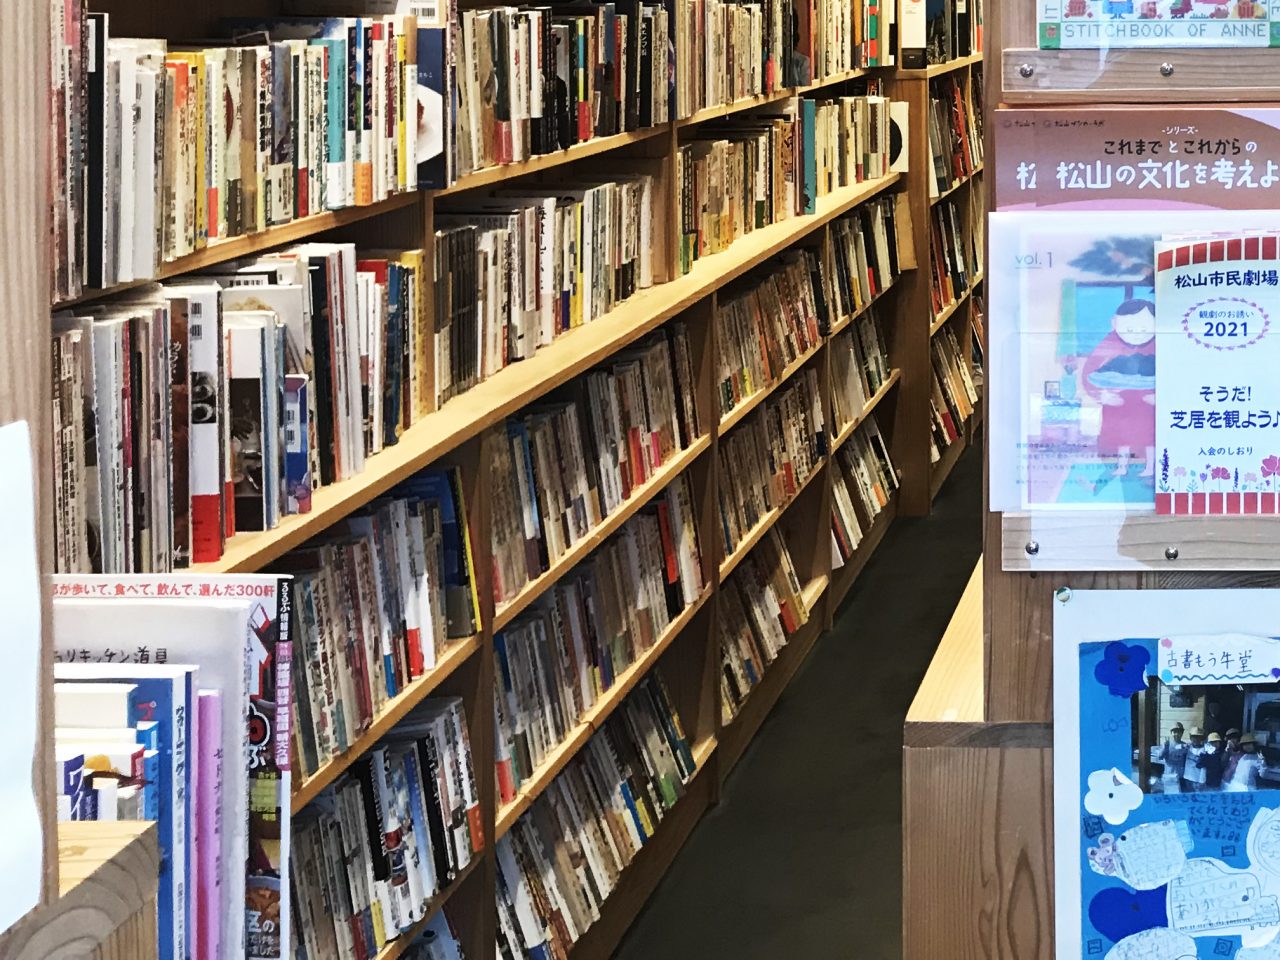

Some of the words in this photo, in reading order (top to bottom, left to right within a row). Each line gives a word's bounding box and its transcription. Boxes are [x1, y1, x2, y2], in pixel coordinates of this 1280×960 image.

[1044, 6, 1058, 20] IT
[1064, 24, 1175, 38] STITCHBOOK
[1187, 23, 1208, 38] OF
[1220, 23, 1267, 38] ANNE
[1173, 269, 1280, 289] 松山市民劇場
[1198, 309, 1255, 319] 観劇のお誘い
[1203, 322, 1249, 338] 2021
[1199, 385, 1253, 403] そうだ!
[1198, 446, 1254, 457] 入会のしおり
[1166, 650, 1254, 675] 古書もう牛堂
